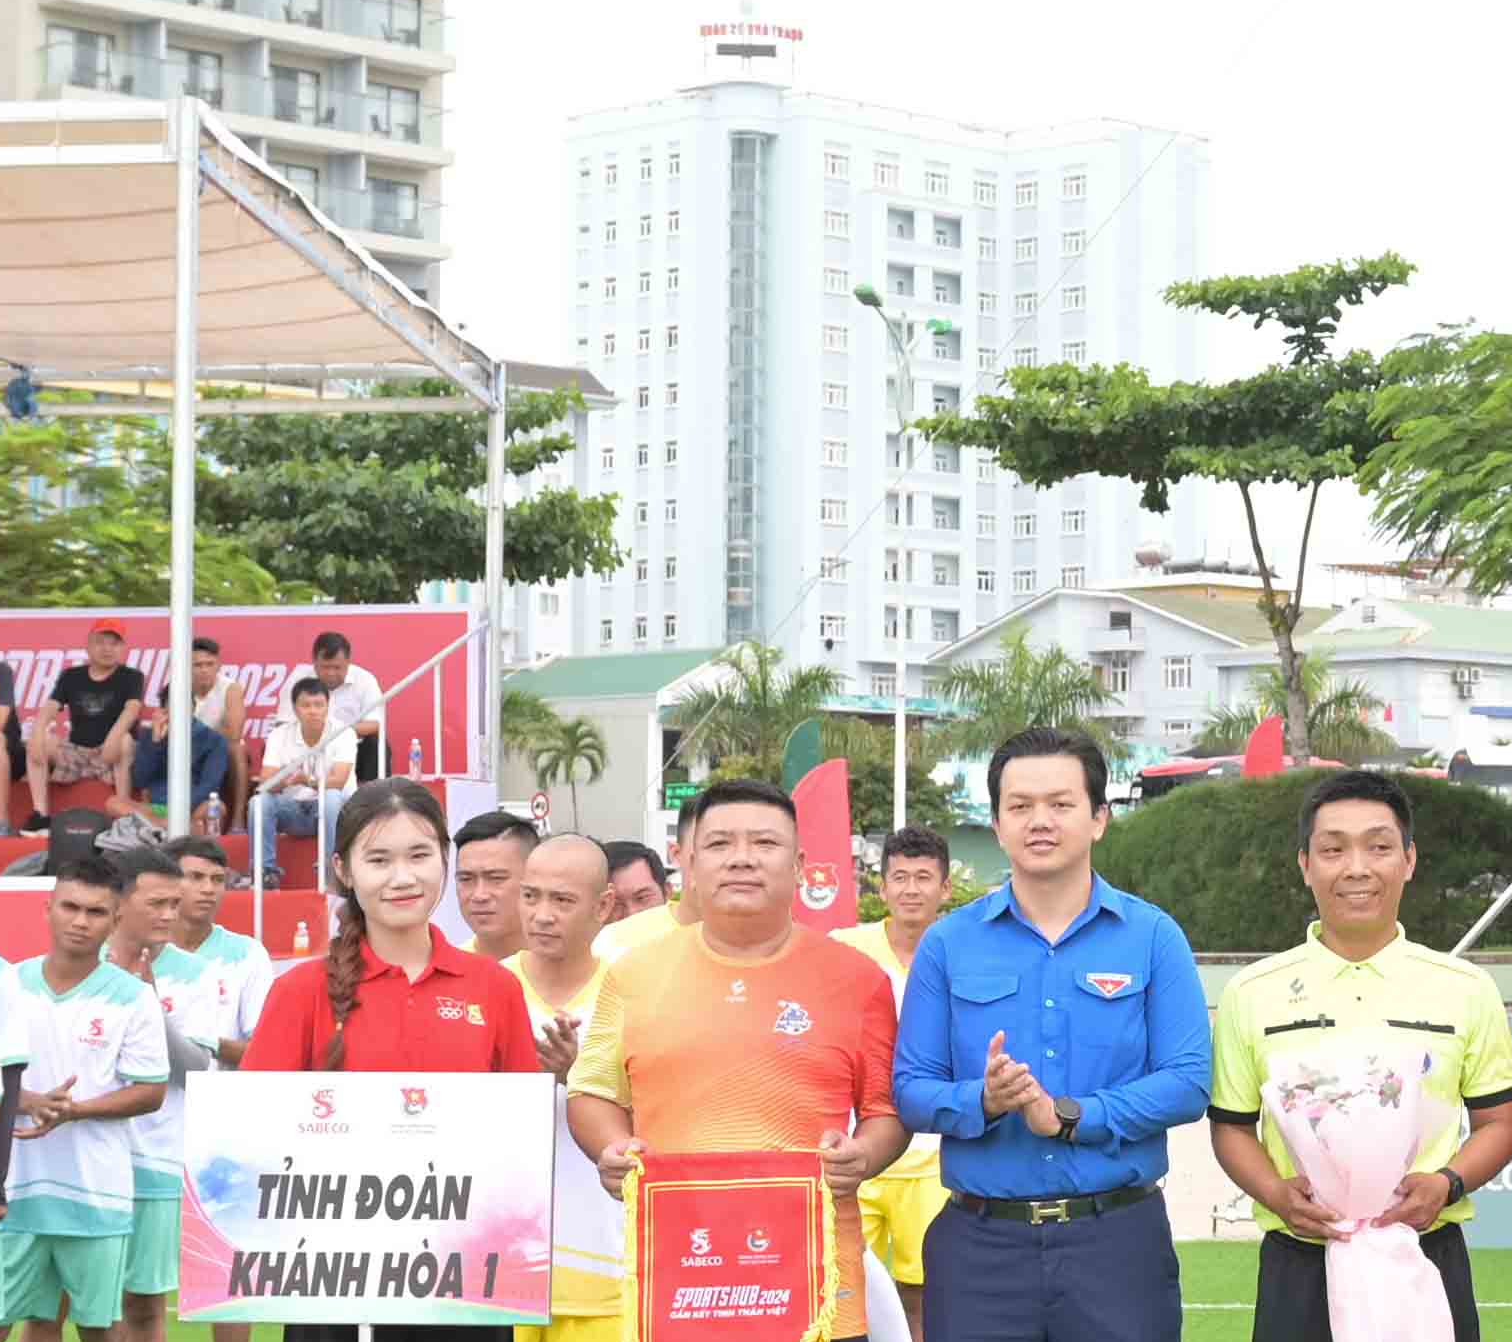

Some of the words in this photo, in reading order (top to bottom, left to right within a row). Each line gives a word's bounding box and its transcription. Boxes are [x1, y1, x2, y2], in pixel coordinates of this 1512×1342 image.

[298, 1123, 349, 1134] SABECO
[257, 1156, 347, 1220] TỈNH
[354, 1161, 472, 1221] ĐOÀN
[228, 1237, 370, 1298] KHÁNH
[378, 1238, 464, 1299] HÒA
[483, 1253, 499, 1299] 1
[680, 1255, 724, 1267] SABECO
[758, 1288, 792, 1305] 2024
